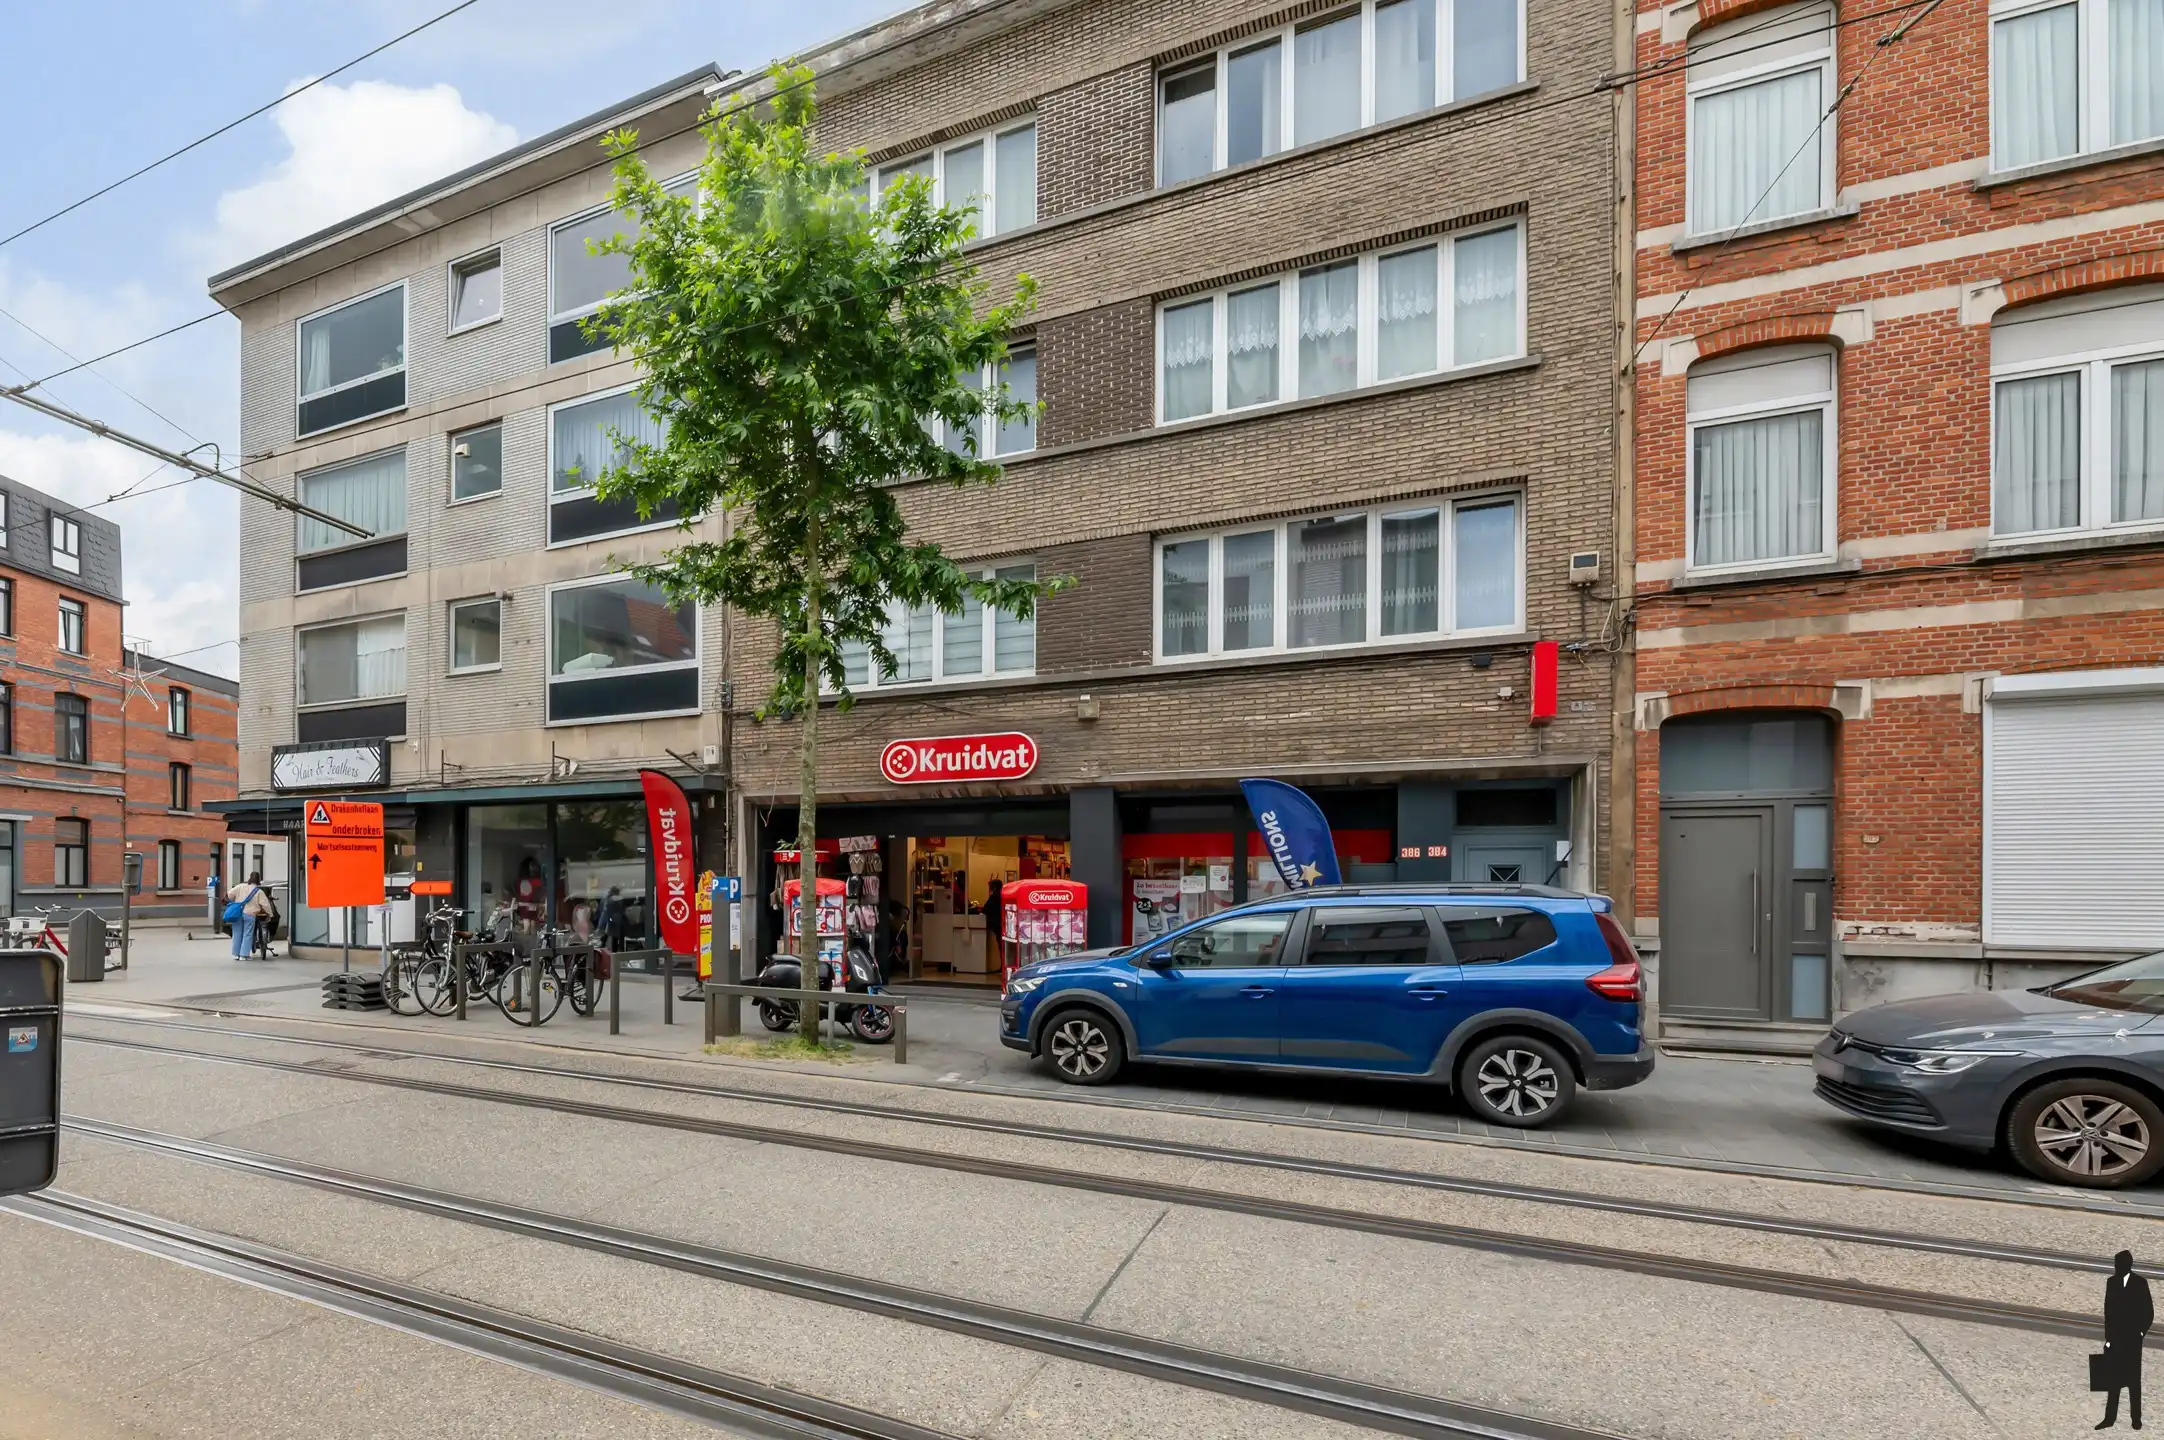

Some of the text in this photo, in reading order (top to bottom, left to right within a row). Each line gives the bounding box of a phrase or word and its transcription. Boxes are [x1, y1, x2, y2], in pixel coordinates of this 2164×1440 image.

[919, 744, 1030, 772] Kruidvat
[292, 756, 359, 783] Hair & Feathers
[1401, 846, 1448, 858] 386 384
[712, 878, 739, 899] P P
[1040, 893, 1070, 901] Kruidvat
